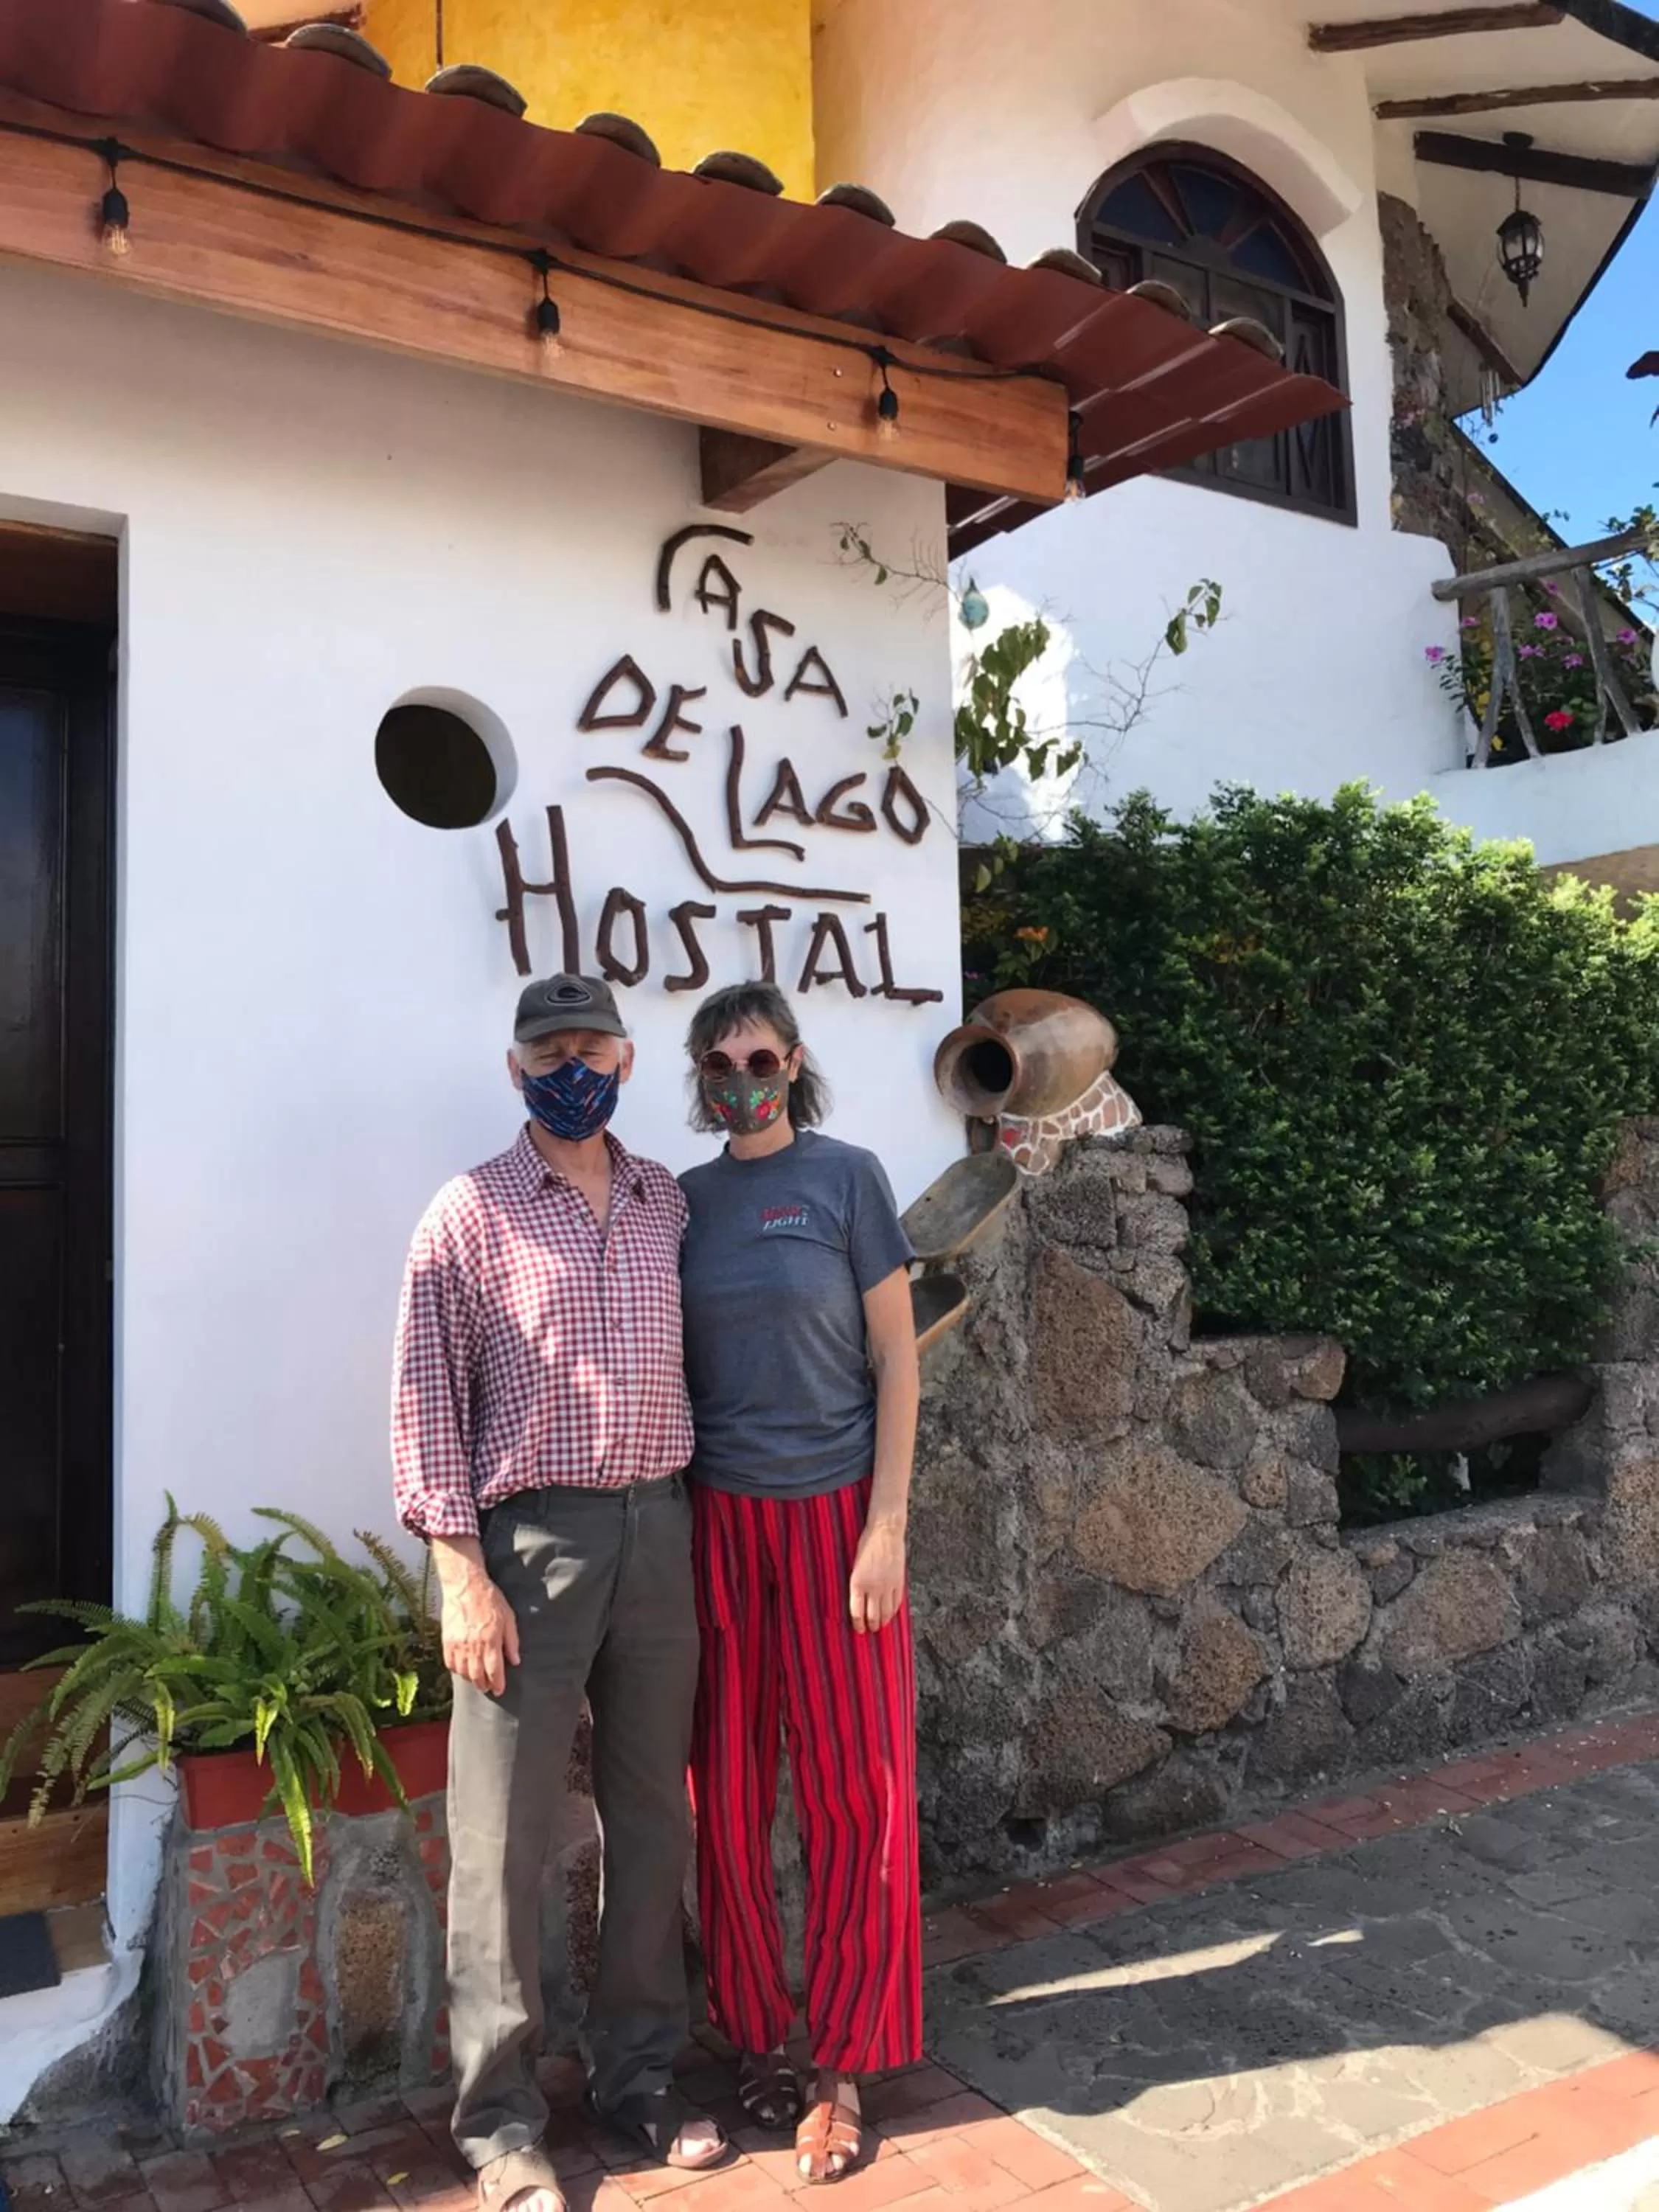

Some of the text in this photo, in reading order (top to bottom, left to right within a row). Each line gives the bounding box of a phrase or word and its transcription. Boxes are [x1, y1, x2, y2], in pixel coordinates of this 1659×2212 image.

[656, 524, 849, 718] CASA
[576, 653, 931, 861] DE LAGO
[495, 804, 944, 1005] HOSTAL
